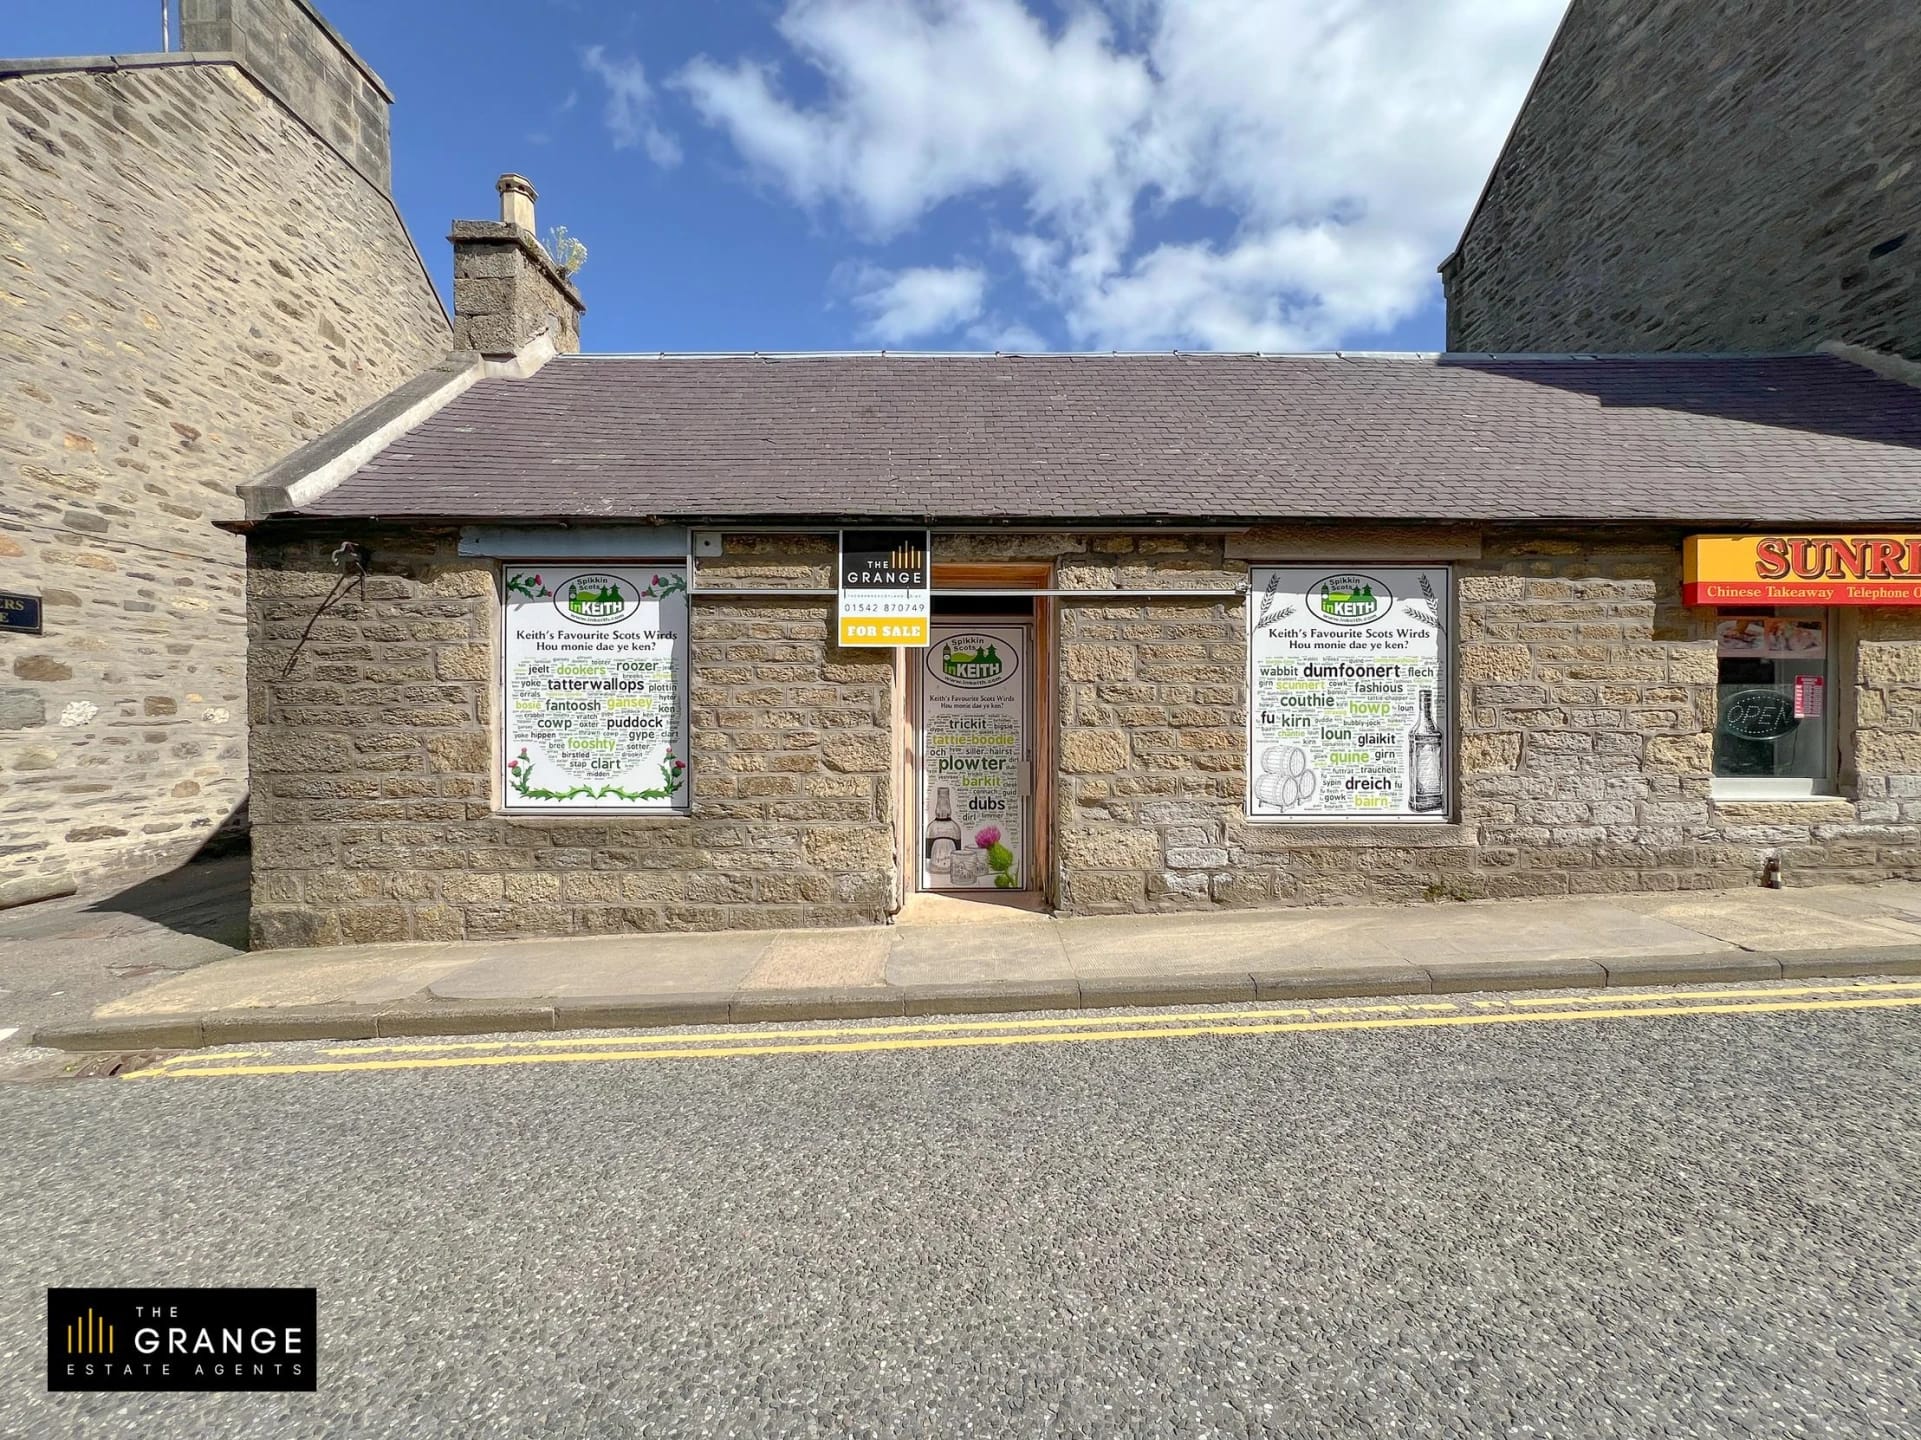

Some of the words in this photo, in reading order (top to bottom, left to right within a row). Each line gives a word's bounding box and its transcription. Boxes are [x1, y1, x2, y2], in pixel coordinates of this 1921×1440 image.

[867, 561, 888, 569] THE
[577, 577, 608, 586] Spikkin
[847, 572, 921, 583] GRANGE
[1330, 577, 1360, 586] Spikkin
[1707, 585, 1761, 597] Chinese
[1765, 586, 1834, 600] Takeaway
[1847, 586, 1909, 601] Telephone
[844, 603, 878, 612] 01542
[884, 603, 925, 612] 870749
[516, 630, 554, 640] Keith's
[558, 630, 610, 640] Favourite
[613, 630, 640, 640] Scots
[644, 630, 678, 640] Wirds
[847, 626, 877, 637] FOR
[882, 626, 921, 637] SALE
[1269, 629, 1307, 638] Keith's
[1311, 629, 1362, 638] Favourite
[1366, 629, 1393, 638] Scots
[1397, 629, 1430, 638] Wirds
[951, 637, 984, 646] Spikkin
[1289, 640, 1311, 649] Hou
[1314, 640, 1346, 649] monie
[1349, 640, 1369, 649] dae
[1370, 642, 1382, 651] ye
[1384, 640, 1409, 649] ken?
[536, 642, 558, 651] Hou
[560, 642, 593, 651] monie
[596, 642, 614, 651] dae
[618, 644, 629, 654] ye
[632, 642, 656, 651] ken?
[528, 664, 549, 675] jeelt
[557, 664, 606, 675] dookers
[616, 662, 658, 671] roozer
[1260, 666, 1298, 676] wabbit
[1304, 663, 1400, 677] dumfoonert
[521, 680, 541, 688] yoke
[548, 678, 644, 693] tatterwallops
[648, 683, 677, 693] plottin
[1276, 681, 1325, 689] scunnert
[1355, 682, 1403, 693] fashious
[515, 700, 542, 709] bosie
[546, 699, 601, 711] fantoosh
[607, 698, 653, 710] gansey
[1281, 693, 1334, 707] couthie
[658, 704, 675, 712] ken
[1350, 701, 1390, 717] howp
[1727, 701, 1789, 724] OPEN
[607, 716, 663, 730] puddock
[1261, 711, 1275, 724] fu
[1282, 714, 1310, 727] kirn
[538, 719, 572, 730] cowp
[950, 719, 986, 729] trickit
[629, 731, 655, 741] gype
[1321, 727, 1351, 740] loun
[568, 737, 615, 752] fooshty
[1358, 733, 1395, 747] glaikit
[930, 748, 946, 756] och
[989, 747, 1012, 755] hairst
[1375, 748, 1395, 761] girn
[591, 758, 621, 769] clart
[939, 755, 1006, 773] plowter
[1330, 752, 1370, 765] quine
[962, 774, 1001, 786] barkit
[1346, 776, 1391, 790] dreich
[969, 796, 1006, 810] dubs
[1324, 794, 1346, 802] gowk
[1355, 794, 1388, 806] bairn
